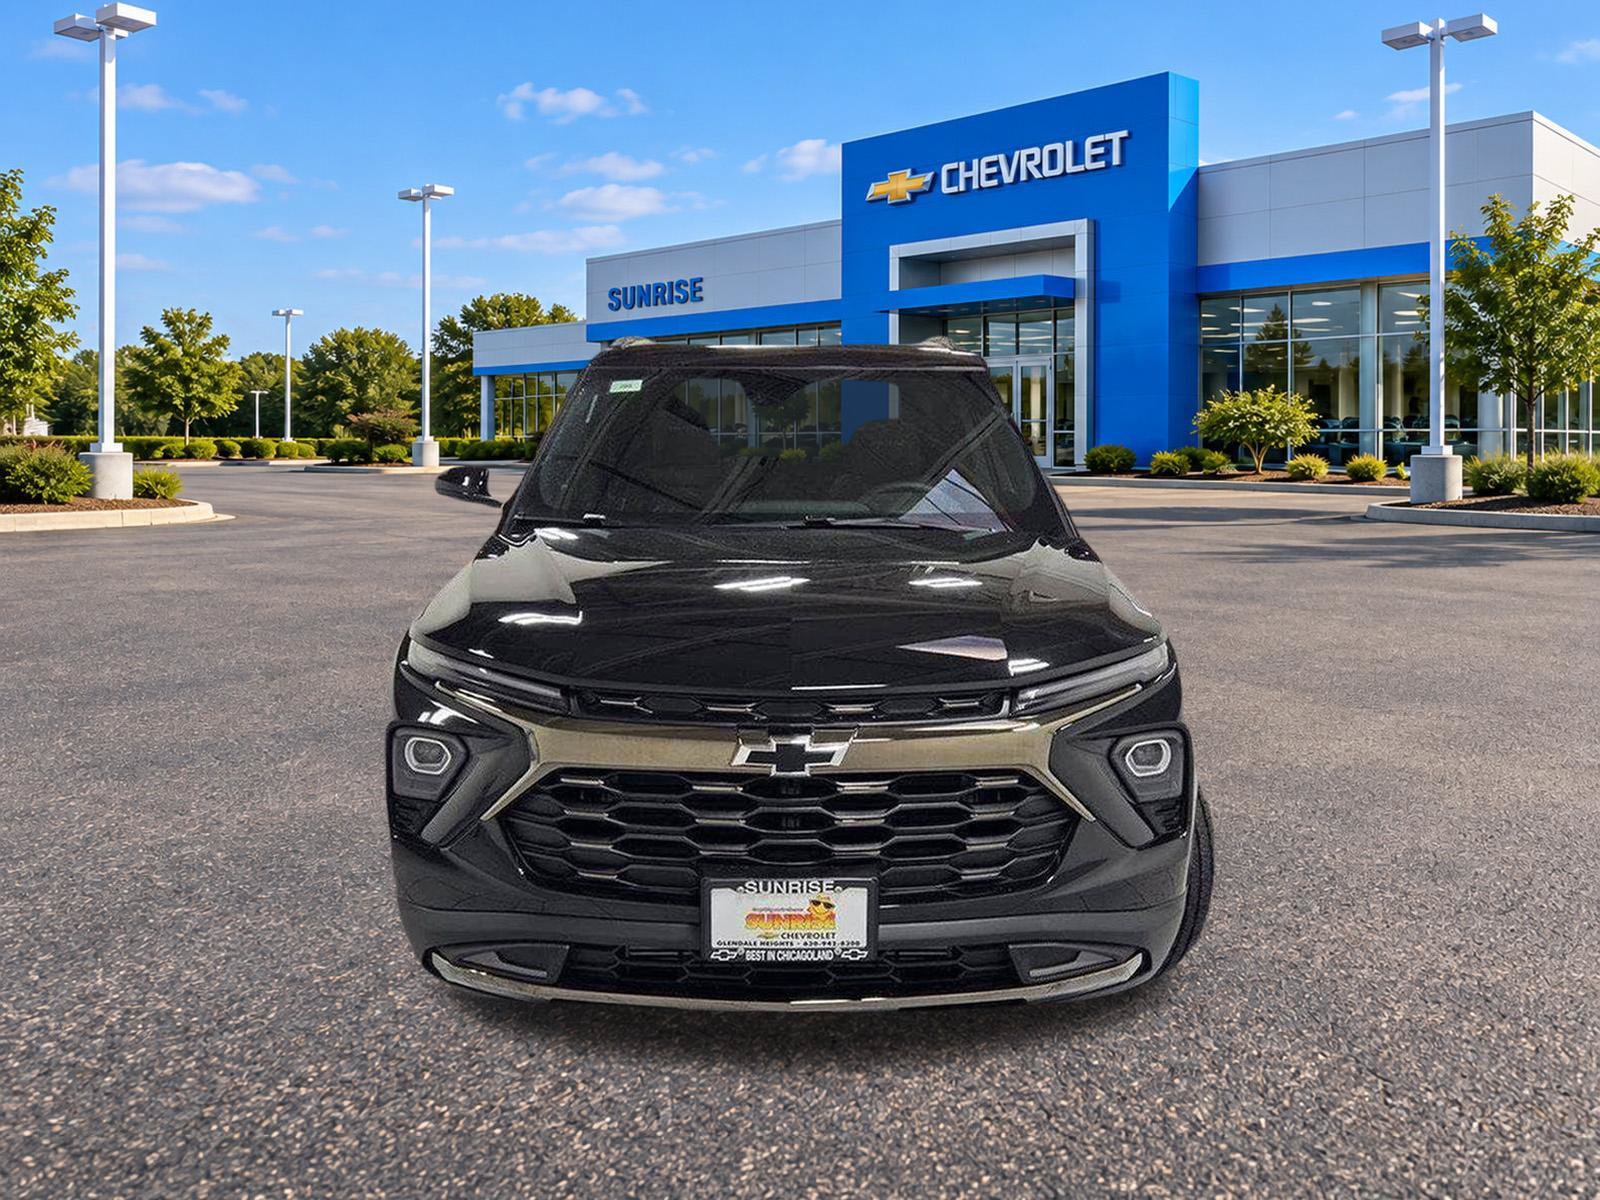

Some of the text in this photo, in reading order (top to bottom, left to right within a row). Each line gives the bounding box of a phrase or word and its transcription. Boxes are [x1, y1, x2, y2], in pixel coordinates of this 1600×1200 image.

[941, 130, 1129, 195] CHEVROLET
[608, 277, 704, 312] SUNRISE
[745, 880, 835, 894] SUNRISE
[781, 932, 836, 940] CHEVROLET
[746, 950, 834, 961] BEST IN CHICAGOLAND
